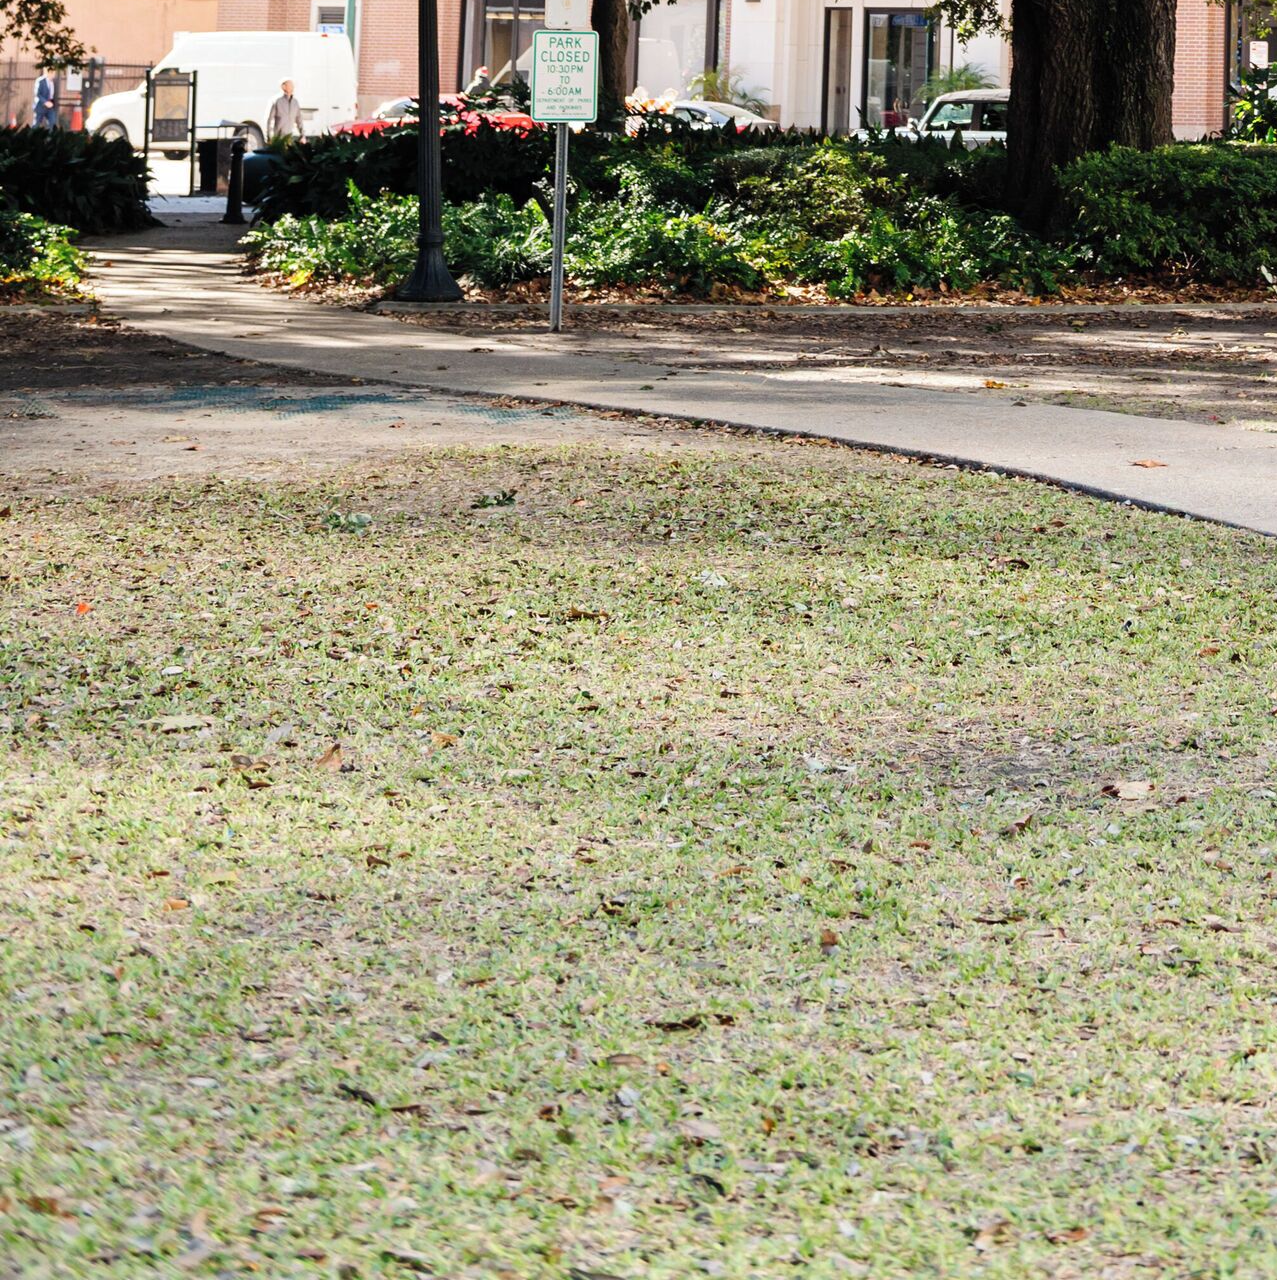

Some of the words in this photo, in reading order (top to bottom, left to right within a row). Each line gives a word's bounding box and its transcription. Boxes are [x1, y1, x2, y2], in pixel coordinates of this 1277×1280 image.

[549, 37, 582, 48] PARK
[541, 51, 590, 62] CLOSED
[560, 76, 570, 84] TO
